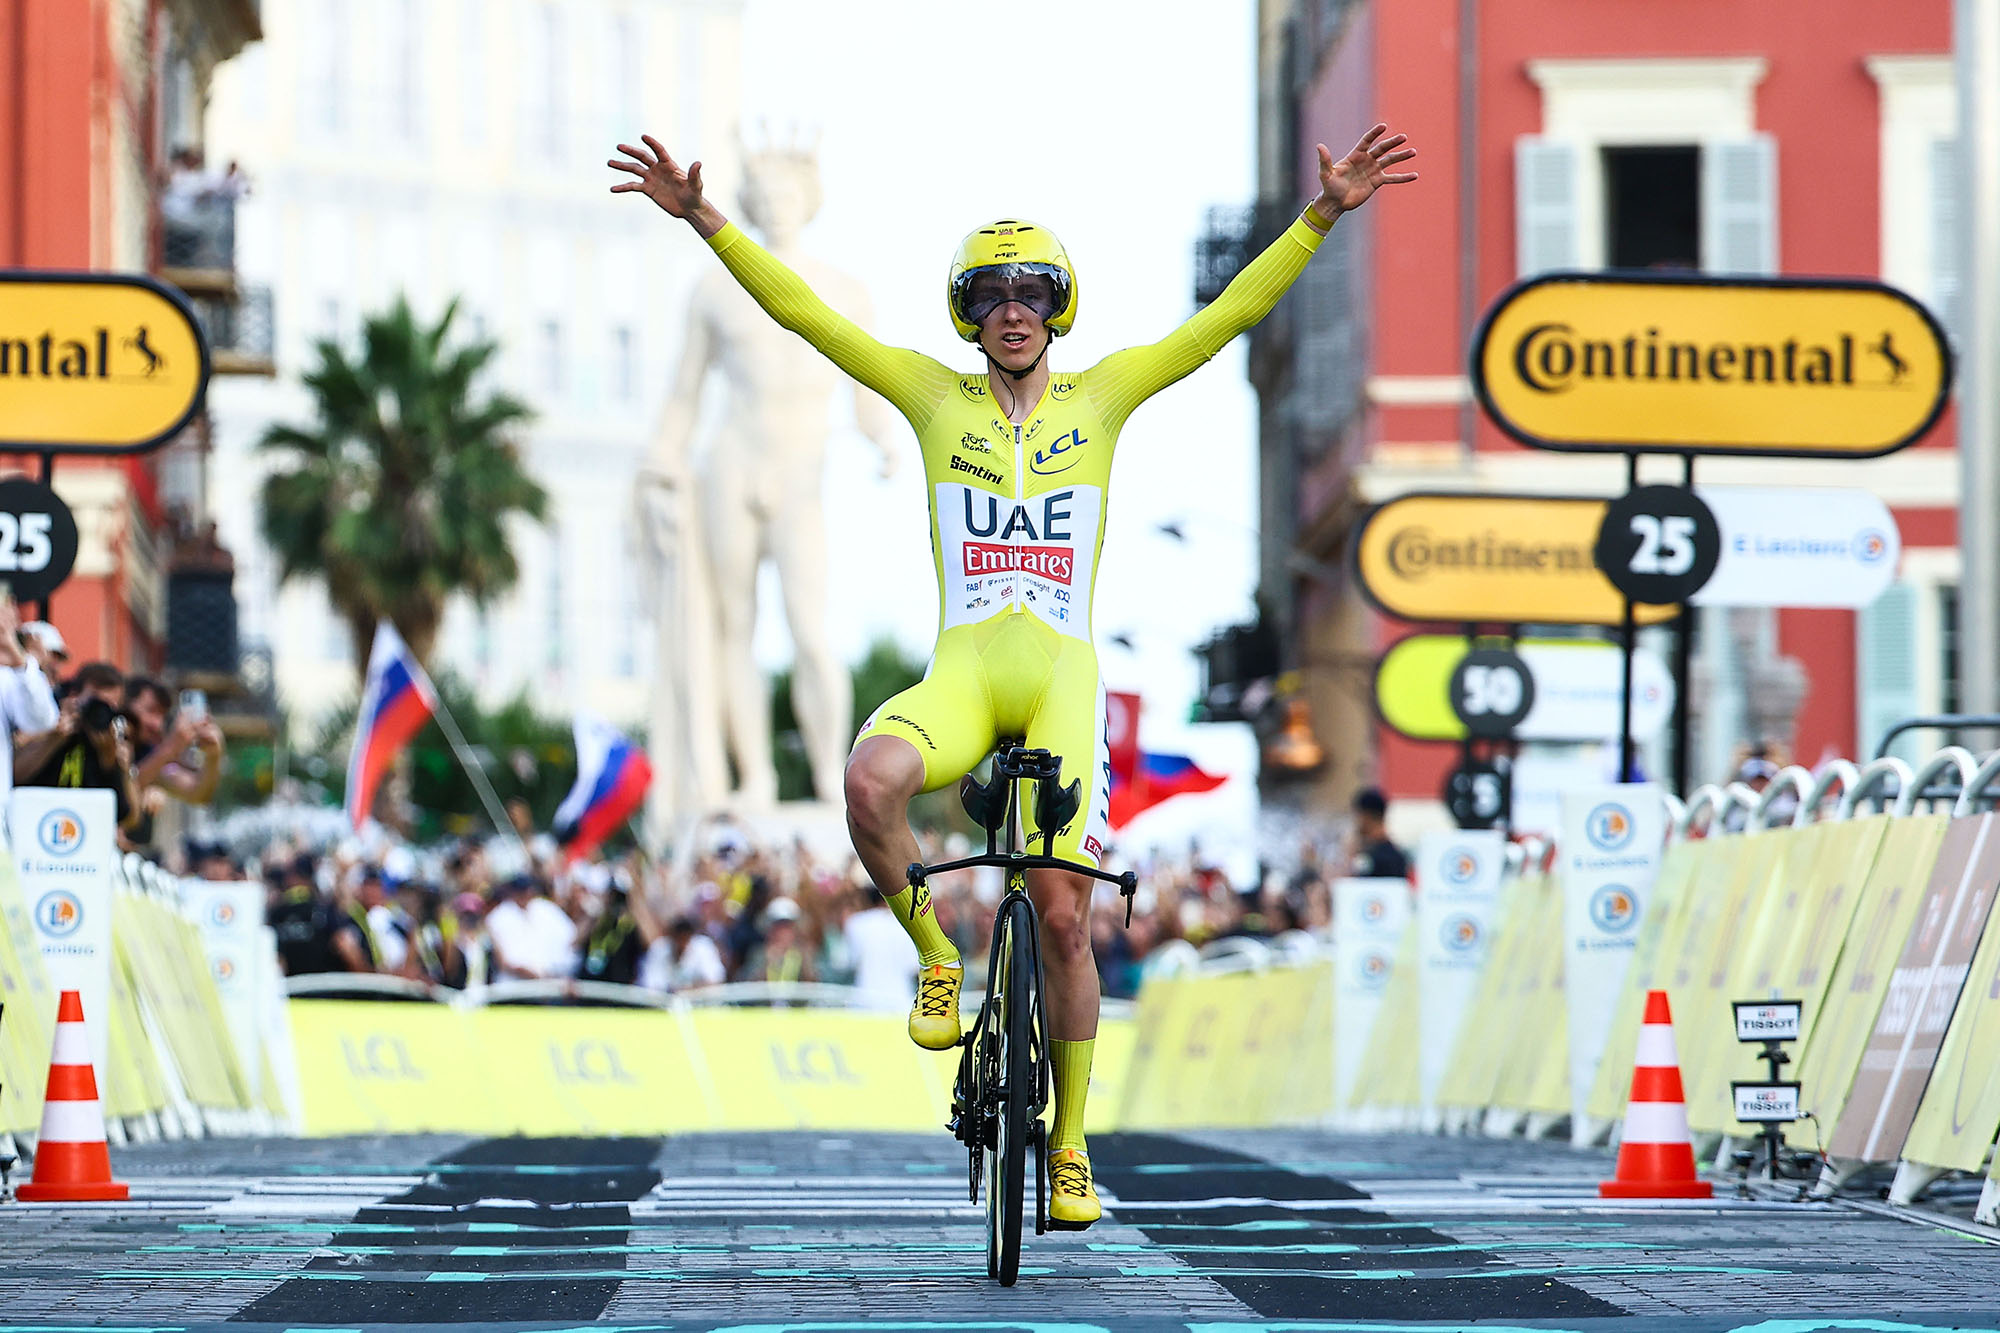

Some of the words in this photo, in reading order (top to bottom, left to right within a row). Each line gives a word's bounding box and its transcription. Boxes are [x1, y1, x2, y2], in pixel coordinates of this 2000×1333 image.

[1514, 324, 1856, 393] Continental
[962, 381, 986, 395] LCL
[1052, 383, 1077, 393] LCL
[1035, 428, 1088, 465] LCL
[949, 454, 1004, 484] Santini
[963, 487, 1074, 541] UAE
[0, 512, 52, 572] 25
[1628, 514, 1697, 576] 25
[965, 545, 1072, 579] Emirates
[966, 582, 979, 592] FAB
[1463, 665, 1524, 716] 50
[884, 714, 937, 750] Santini
[1742, 1019, 1794, 1029] TISSOT
[1742, 1101, 1792, 1111] TISSOT
